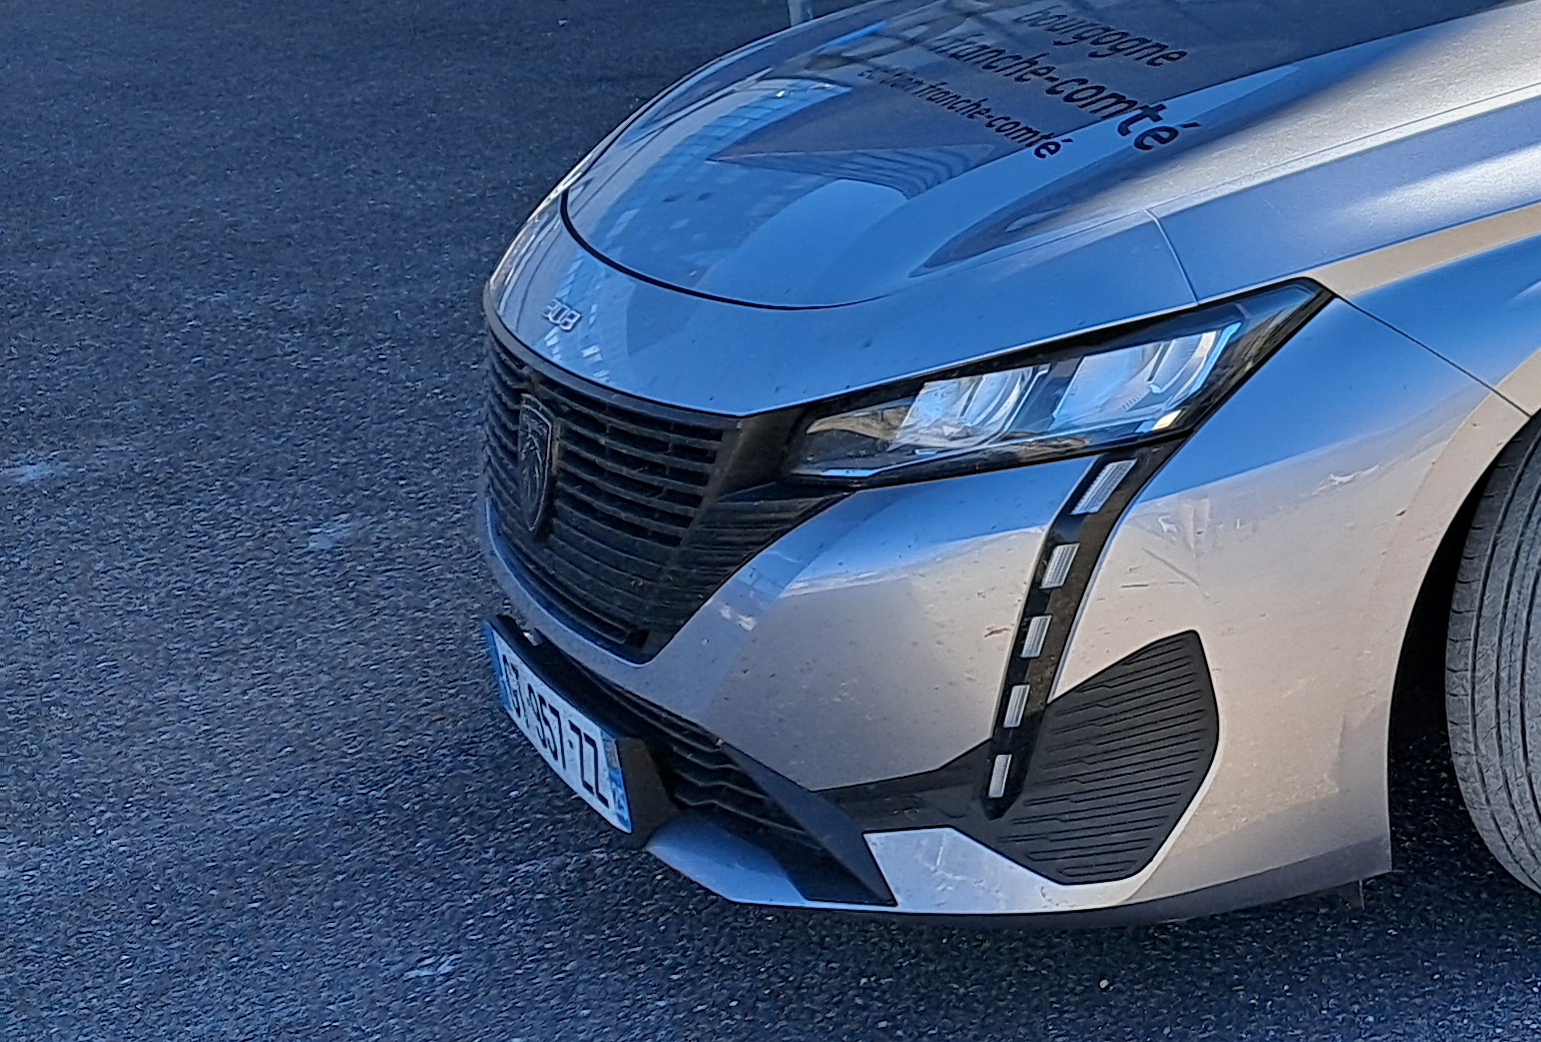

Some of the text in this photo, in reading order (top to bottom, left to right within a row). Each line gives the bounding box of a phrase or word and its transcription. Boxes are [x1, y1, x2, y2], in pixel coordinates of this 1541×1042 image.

[1012, 4, 1188, 68] bourgogne
[912, 80, 1074, 160] franche-comté
[927, 32, 1201, 152] franche-comté
[541, 298, 581, 331] 308
